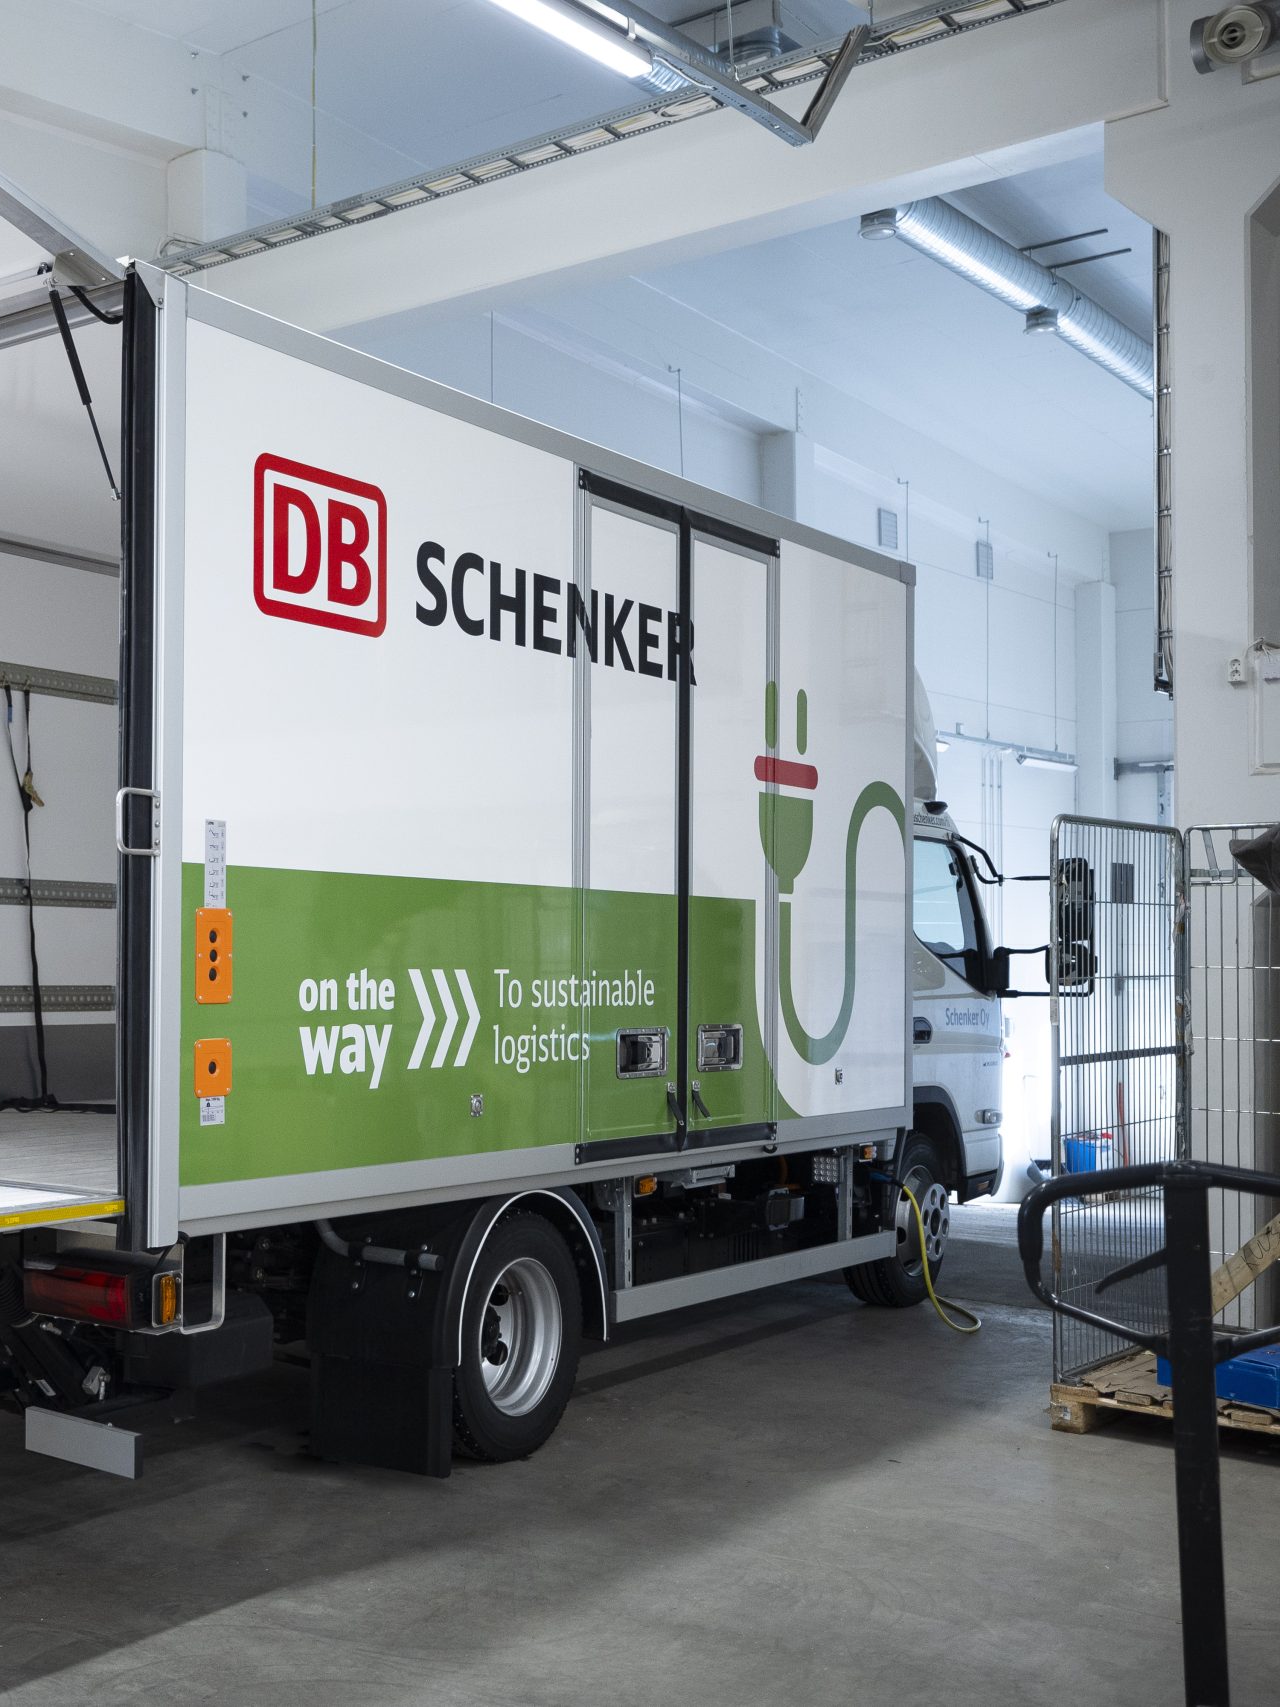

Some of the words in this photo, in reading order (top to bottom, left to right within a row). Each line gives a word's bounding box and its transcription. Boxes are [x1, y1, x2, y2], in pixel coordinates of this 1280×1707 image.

[273, 482, 372, 607] DB
[416, 540, 697, 686] SCHENKER
[299, 978, 338, 1012] on
[346, 968, 395, 1011] the
[494, 968, 522, 1008] To
[531, 970, 655, 1007] sustainable
[945, 1007, 979, 1026] Schenker
[980, 1008, 990, 1030] Oy
[299, 1023, 393, 1090] way
[493, 1023, 590, 1074] logistics
